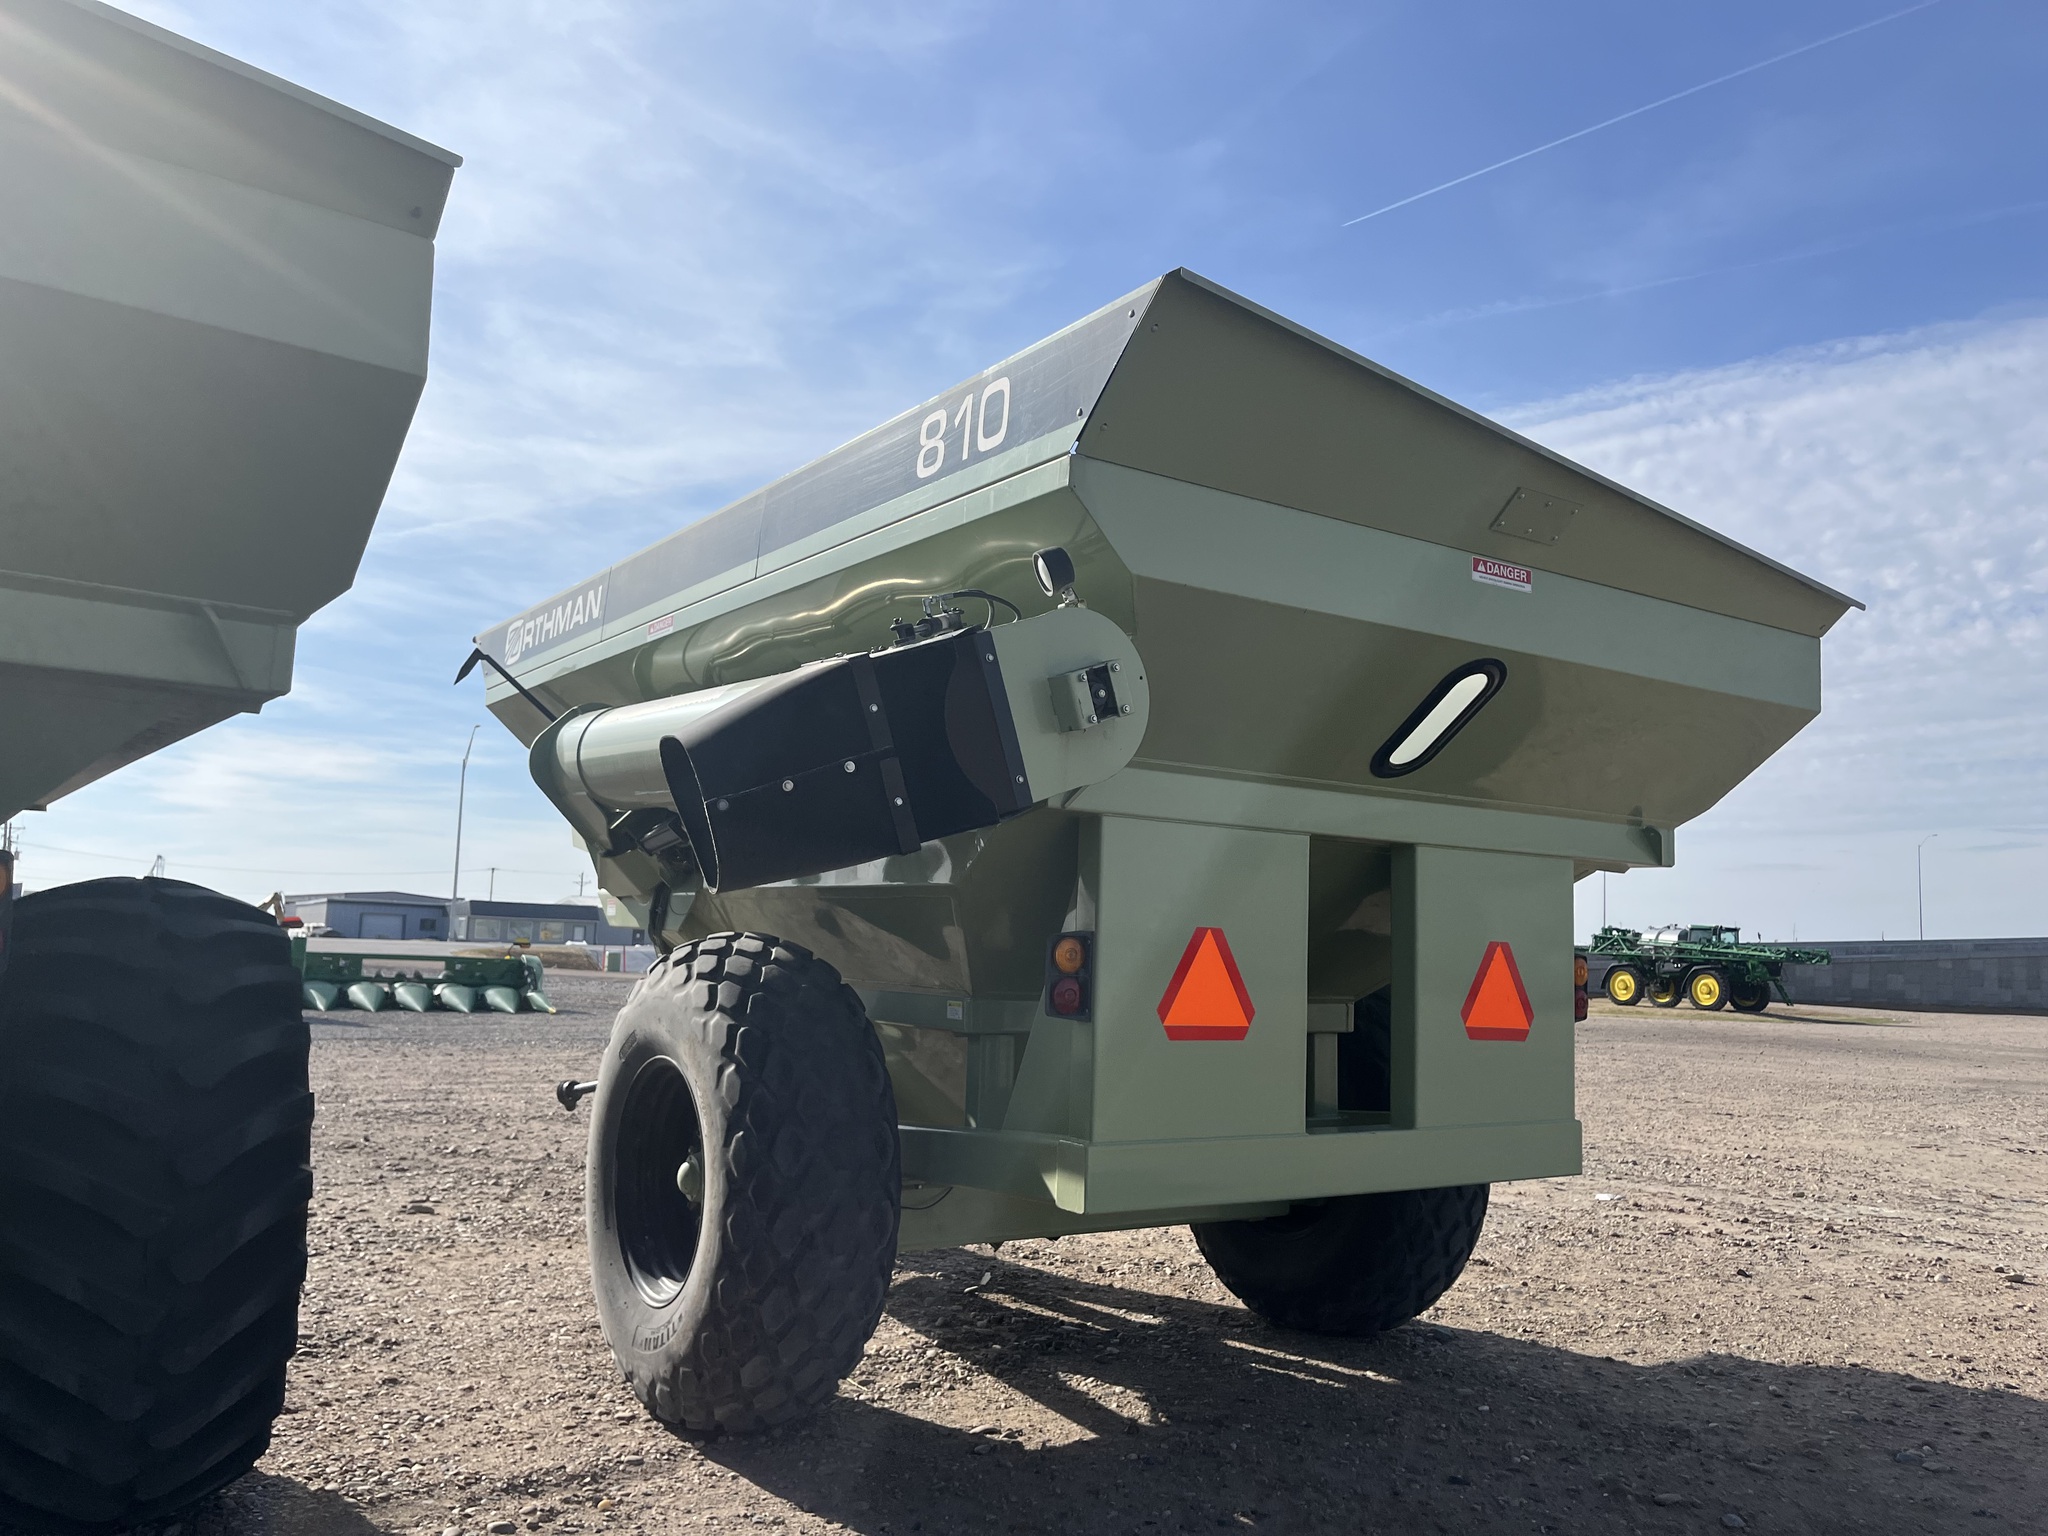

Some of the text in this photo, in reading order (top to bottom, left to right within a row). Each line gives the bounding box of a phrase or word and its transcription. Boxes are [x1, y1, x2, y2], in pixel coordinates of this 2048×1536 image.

[916, 376, 1011, 479] 810
[1486, 562, 1528, 582] DANGER
[505, 585, 603, 666] ORTHMAN
